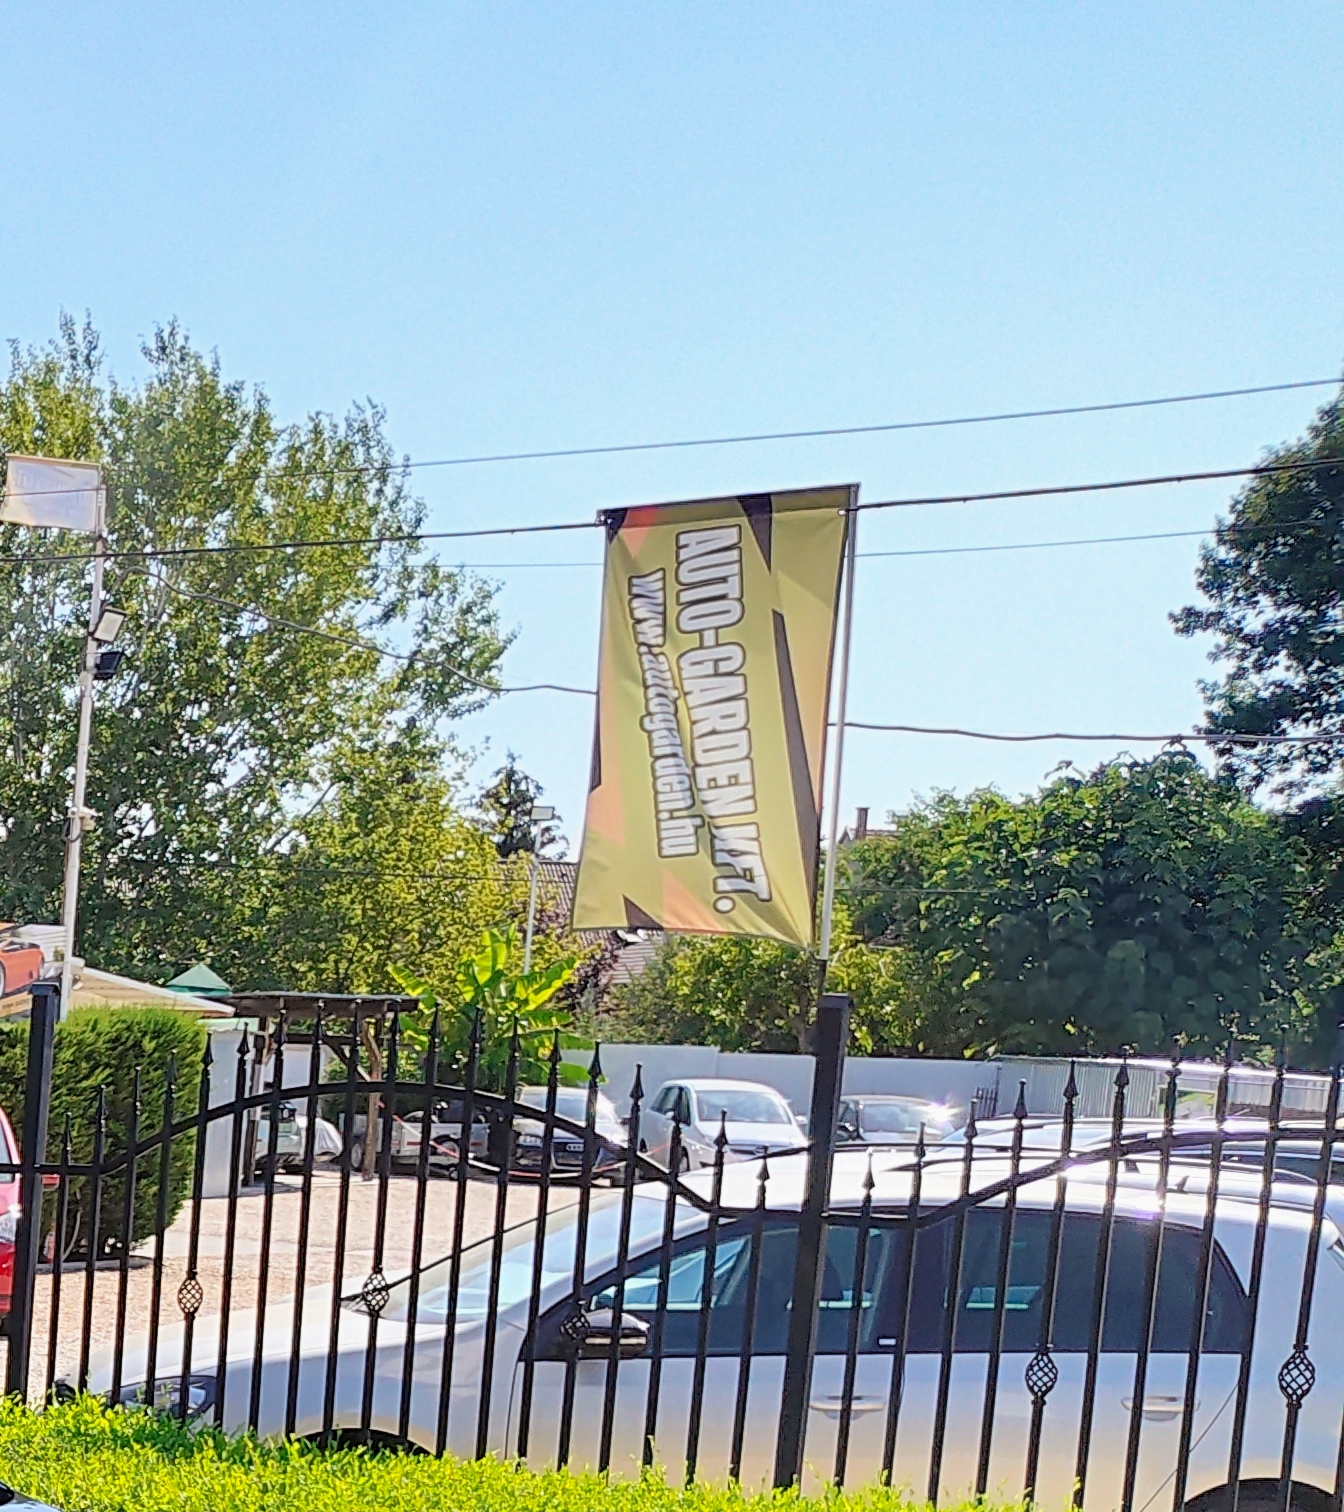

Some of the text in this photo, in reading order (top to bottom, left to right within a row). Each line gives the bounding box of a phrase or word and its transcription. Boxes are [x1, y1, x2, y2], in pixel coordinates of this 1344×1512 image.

[628, 567, 704, 859] www.autogarden.hu
[676, 523, 772, 914] AUTO-GARDEN KFT.
